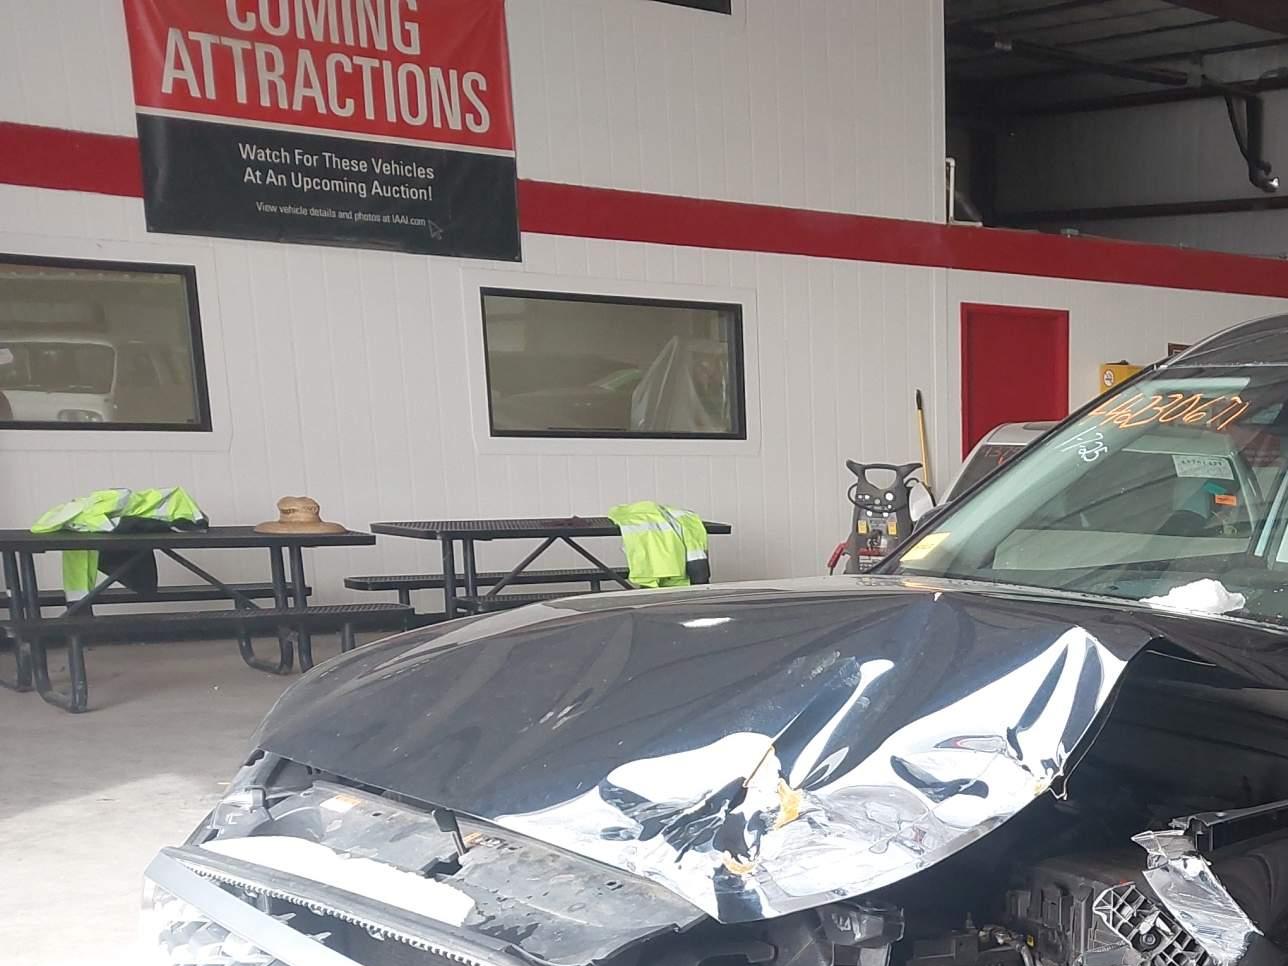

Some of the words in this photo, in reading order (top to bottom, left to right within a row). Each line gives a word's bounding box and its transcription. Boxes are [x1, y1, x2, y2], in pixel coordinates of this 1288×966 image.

[161, 27, 490, 134] ATTRACTIONS
[239, 143, 290, 165] Watch
[295, 149, 319, 168] For
[322, 152, 368, 173] These
[372, 158, 435, 180] Vehicles
[244, 167, 262, 185] At
[266, 168, 287, 187] An
[291, 171, 367, 198] Upcoming
[371, 180, 433, 201] Auction!
[256, 201, 277, 213] View
[279, 206, 308, 216] vehicle
[310, 208, 336, 218] details
[338, 211, 353, 220] and
[355, 212, 381, 222] photos
[382, 215, 391, 223] at
